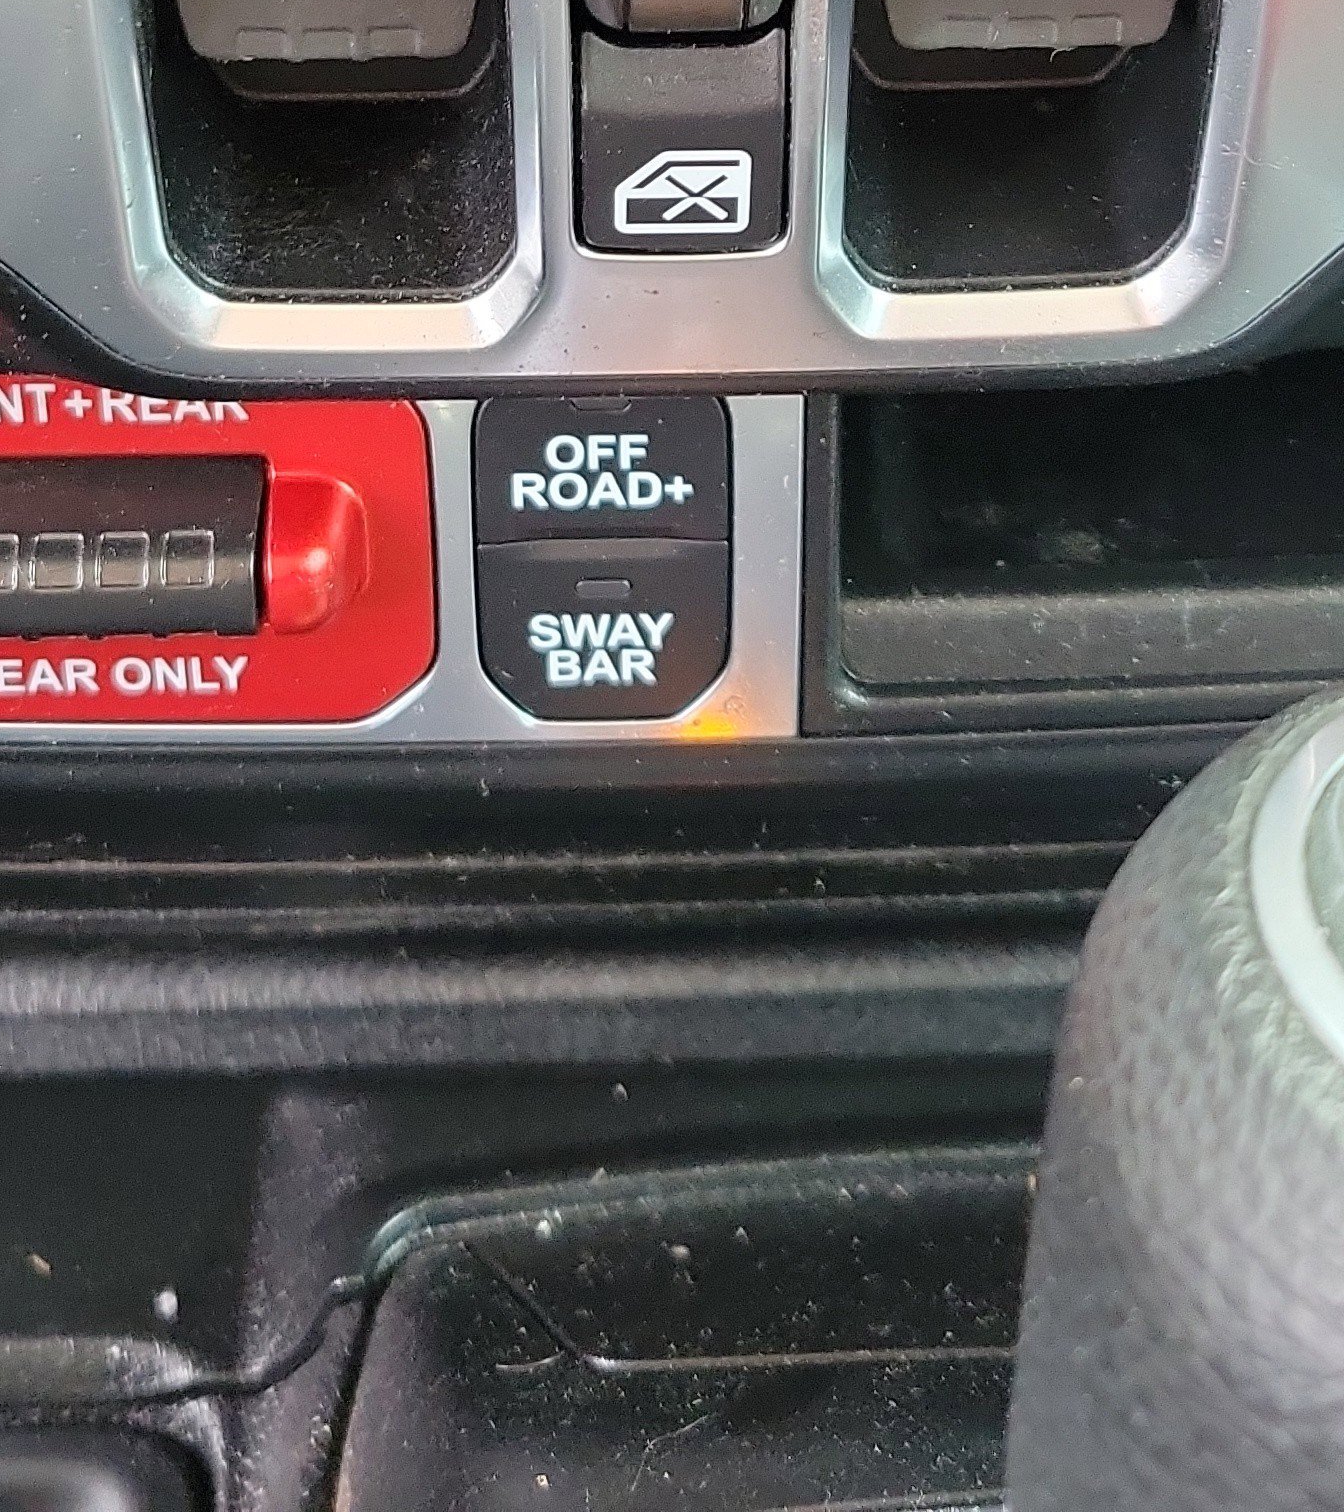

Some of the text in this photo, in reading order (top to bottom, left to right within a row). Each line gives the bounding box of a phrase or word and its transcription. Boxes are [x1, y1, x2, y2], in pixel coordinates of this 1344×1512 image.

[545, 434, 649, 471] OFF
[511, 471, 694, 510] ROAD+
[528, 612, 674, 651] SWAY
[113, 657, 249, 694] ONLY
[546, 648, 657, 688] BAR
